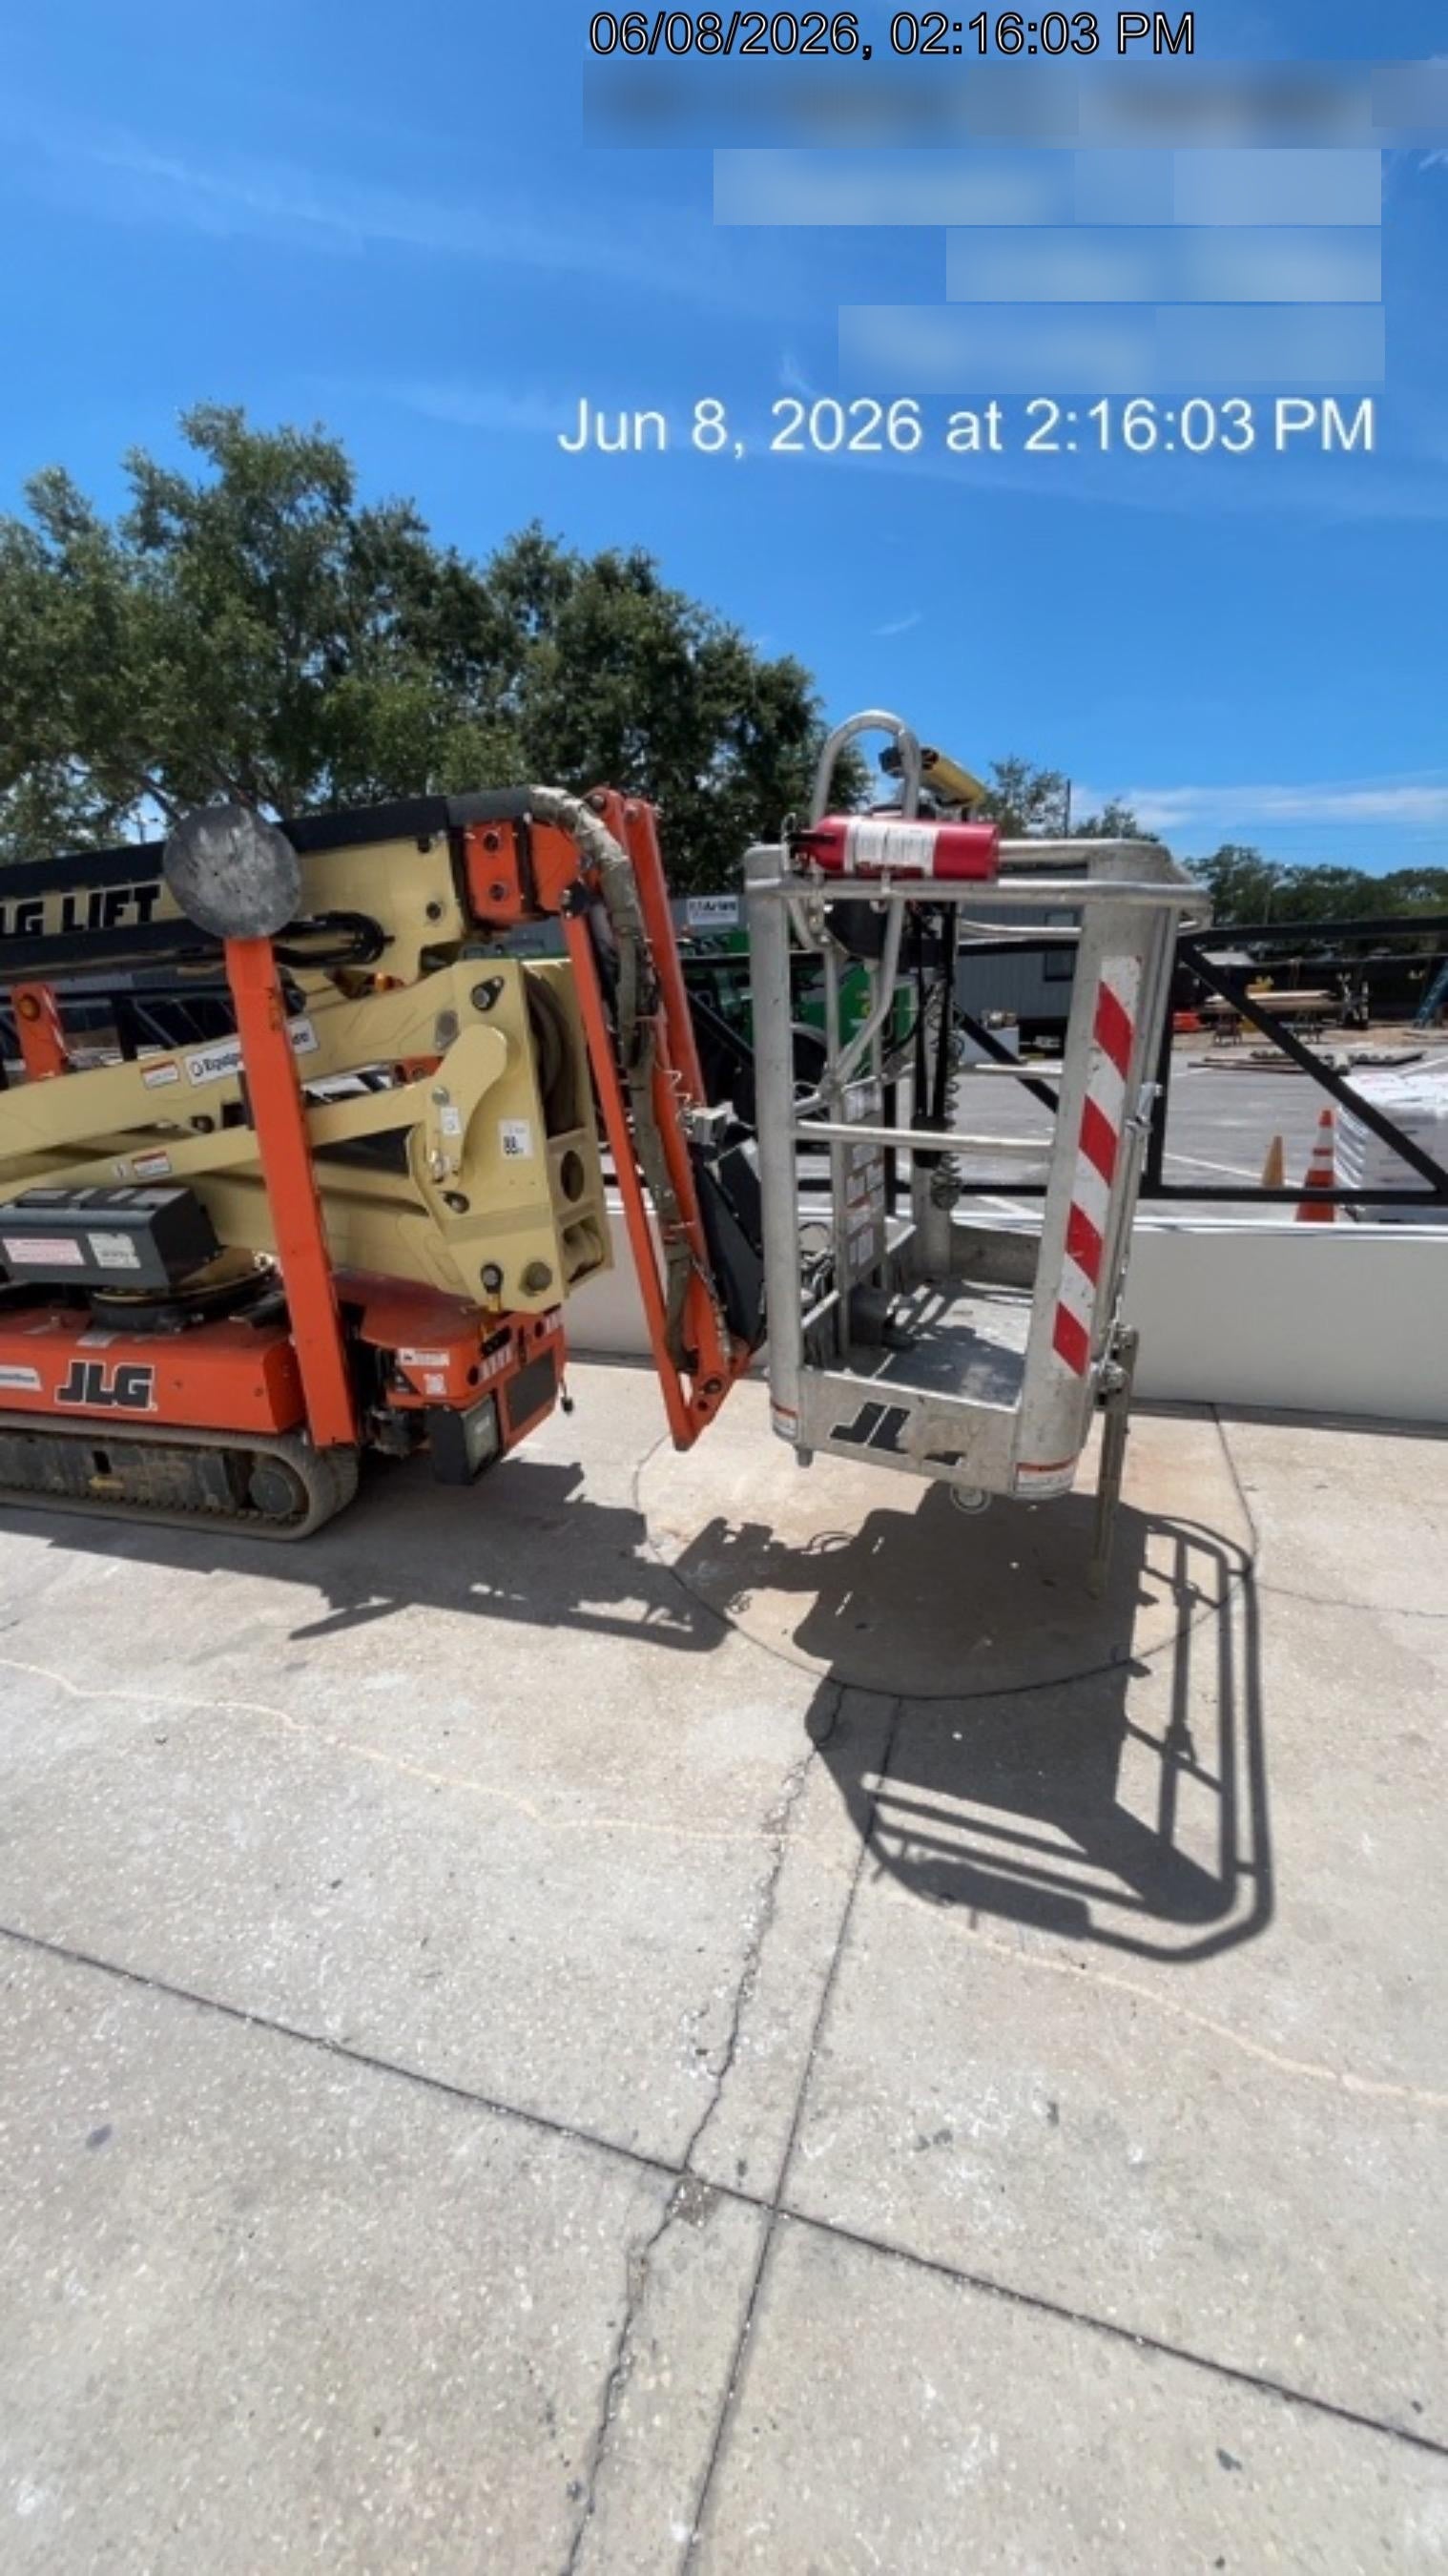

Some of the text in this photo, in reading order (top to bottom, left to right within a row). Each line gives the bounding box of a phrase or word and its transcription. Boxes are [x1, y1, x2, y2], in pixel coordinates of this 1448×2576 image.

[61, 882, 161, 932] LIFT
[54, 1360, 155, 1411] JLG
[829, 1401, 966, 1466] JL
